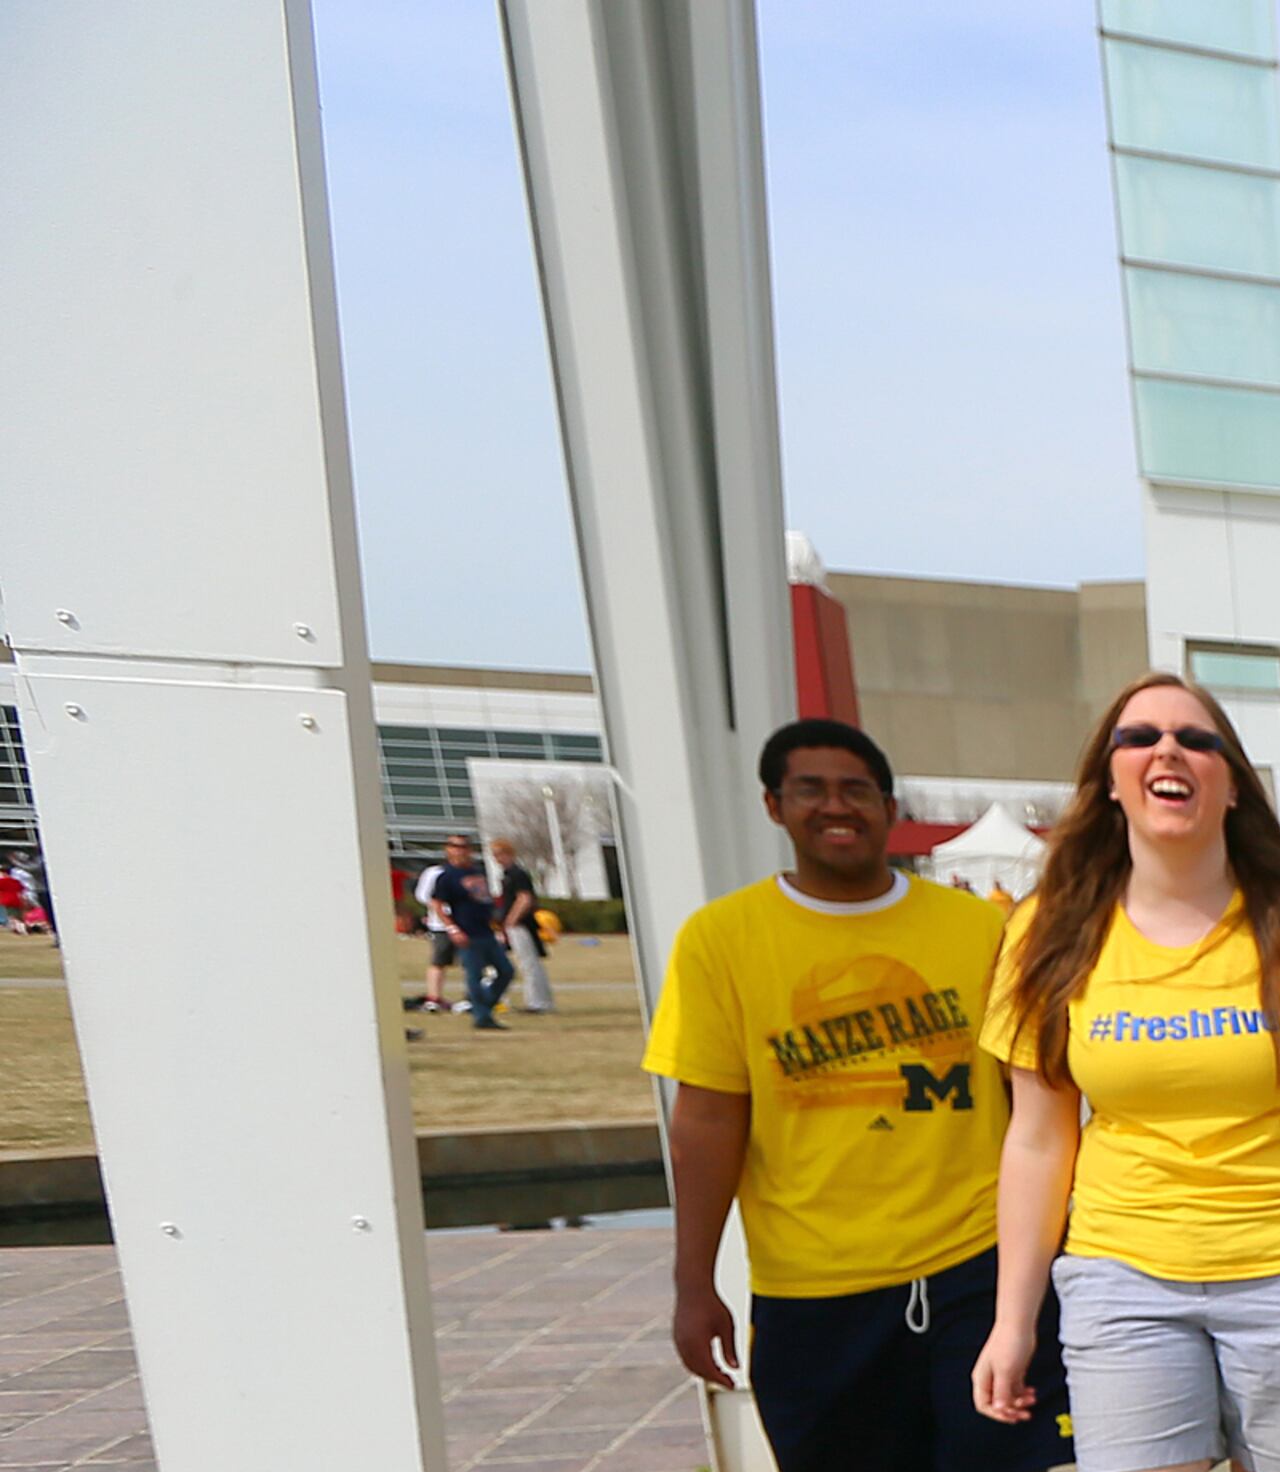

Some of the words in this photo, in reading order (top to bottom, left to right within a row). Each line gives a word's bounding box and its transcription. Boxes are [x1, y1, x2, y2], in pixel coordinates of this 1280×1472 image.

[768, 1011, 885, 1076] MAIZE
[877, 988, 969, 1044] RAGE
[900, 1063, 974, 1111] M
